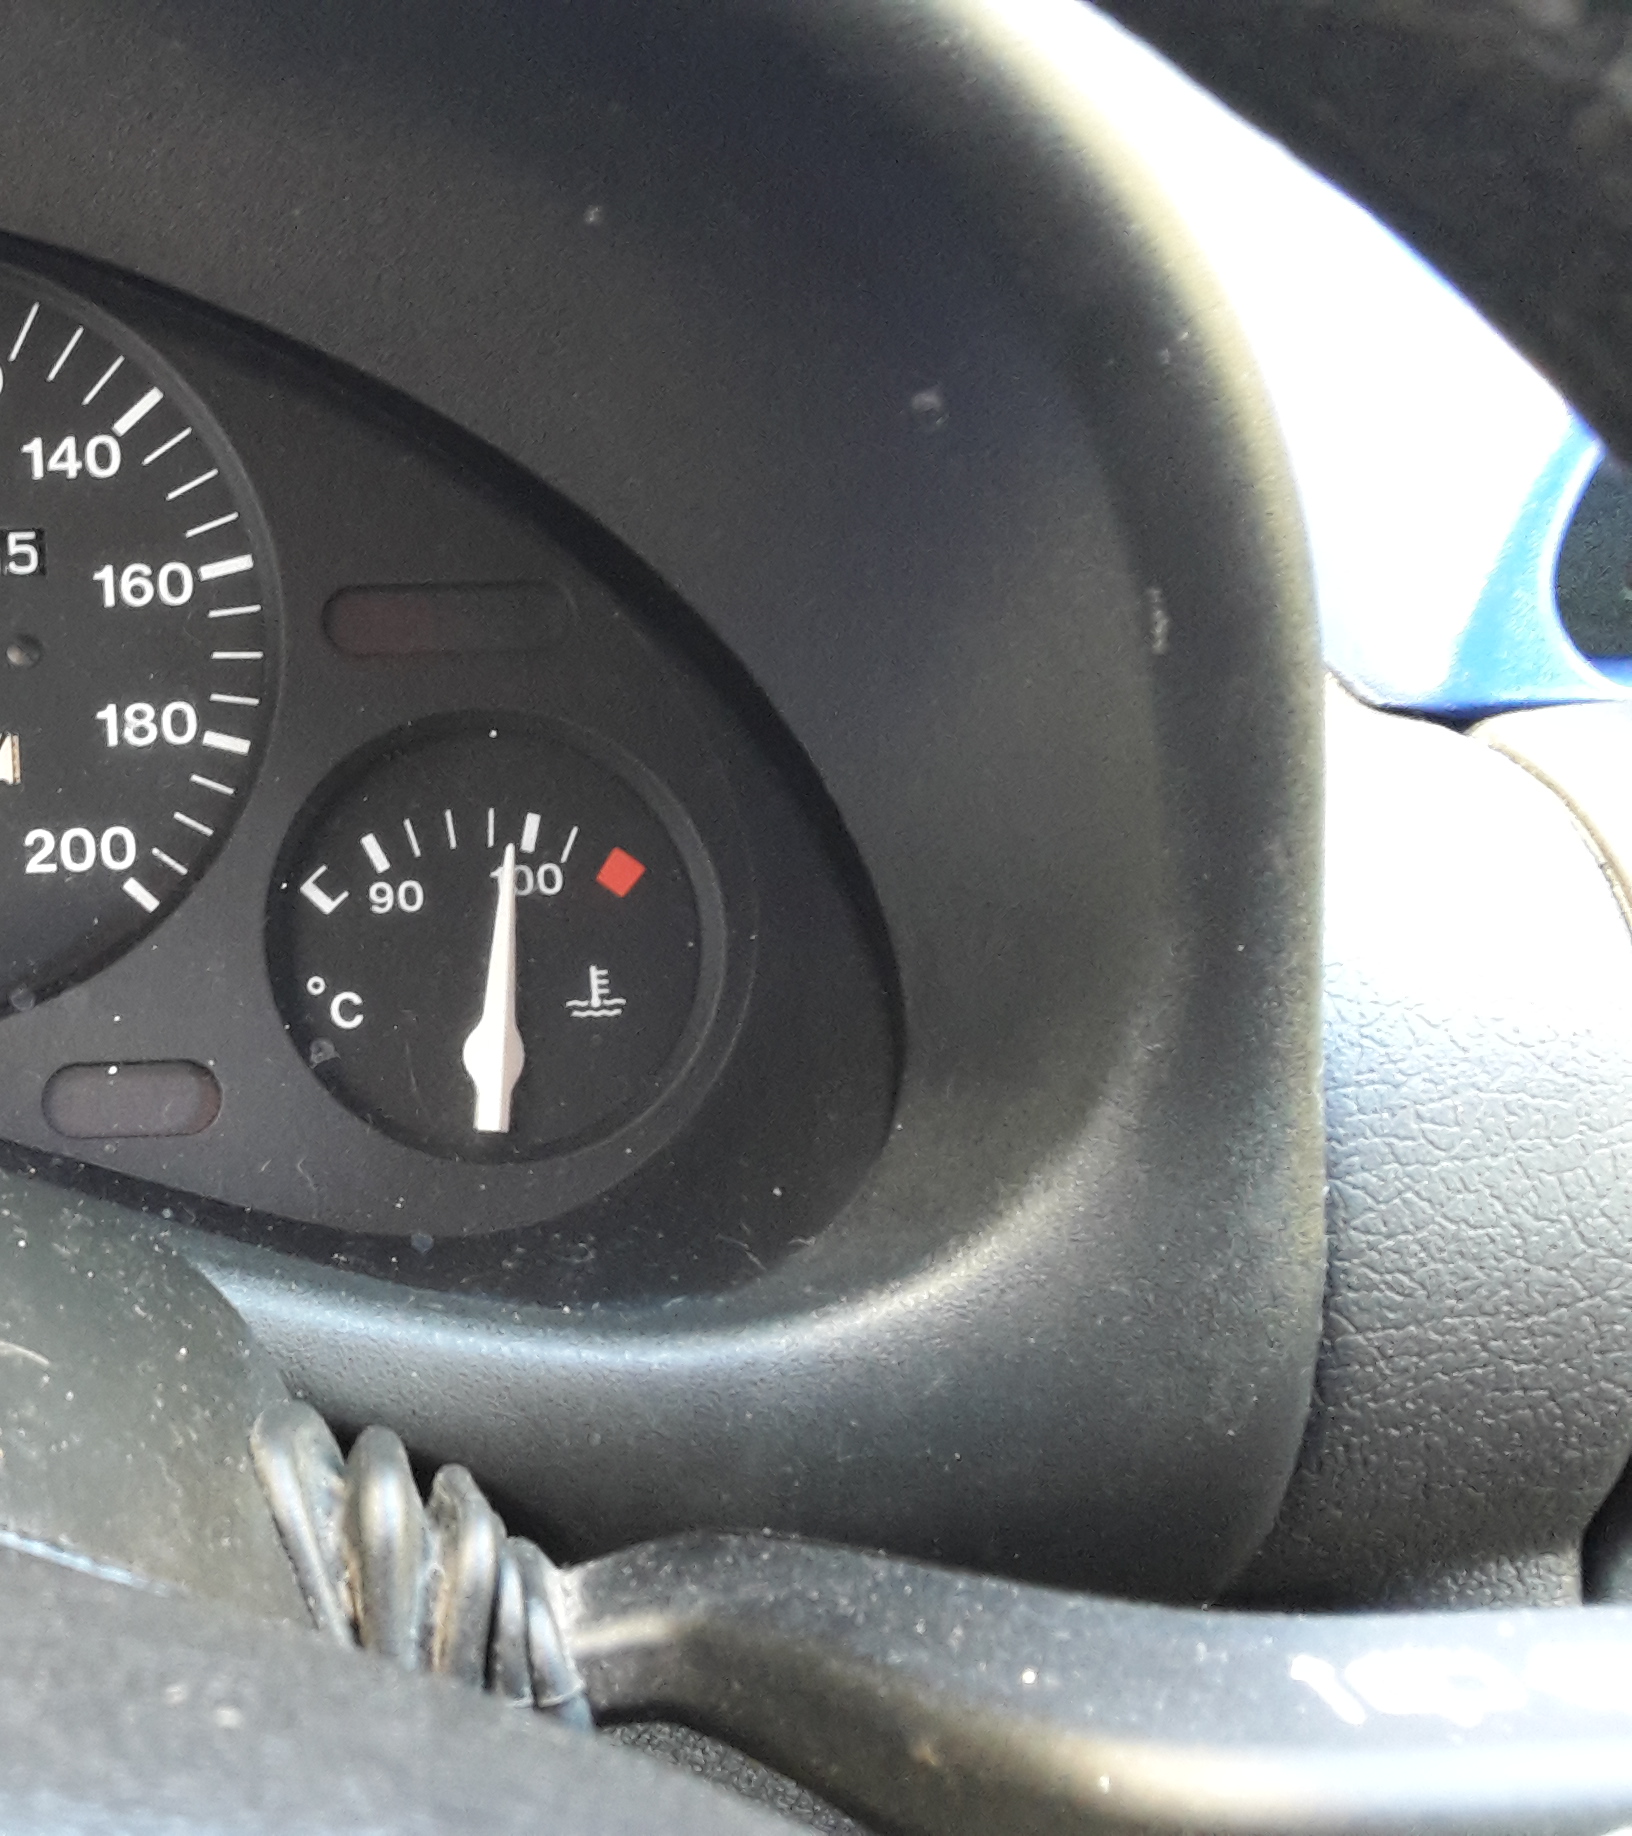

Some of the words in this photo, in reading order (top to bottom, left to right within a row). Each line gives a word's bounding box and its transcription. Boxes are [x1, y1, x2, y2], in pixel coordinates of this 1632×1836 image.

[21, 434, 121, 479] 140
[92, 561, 194, 608] 160
[95, 700, 198, 748] 180
[23, 826, 137, 874] 200
[369, 879, 424, 914] 90
